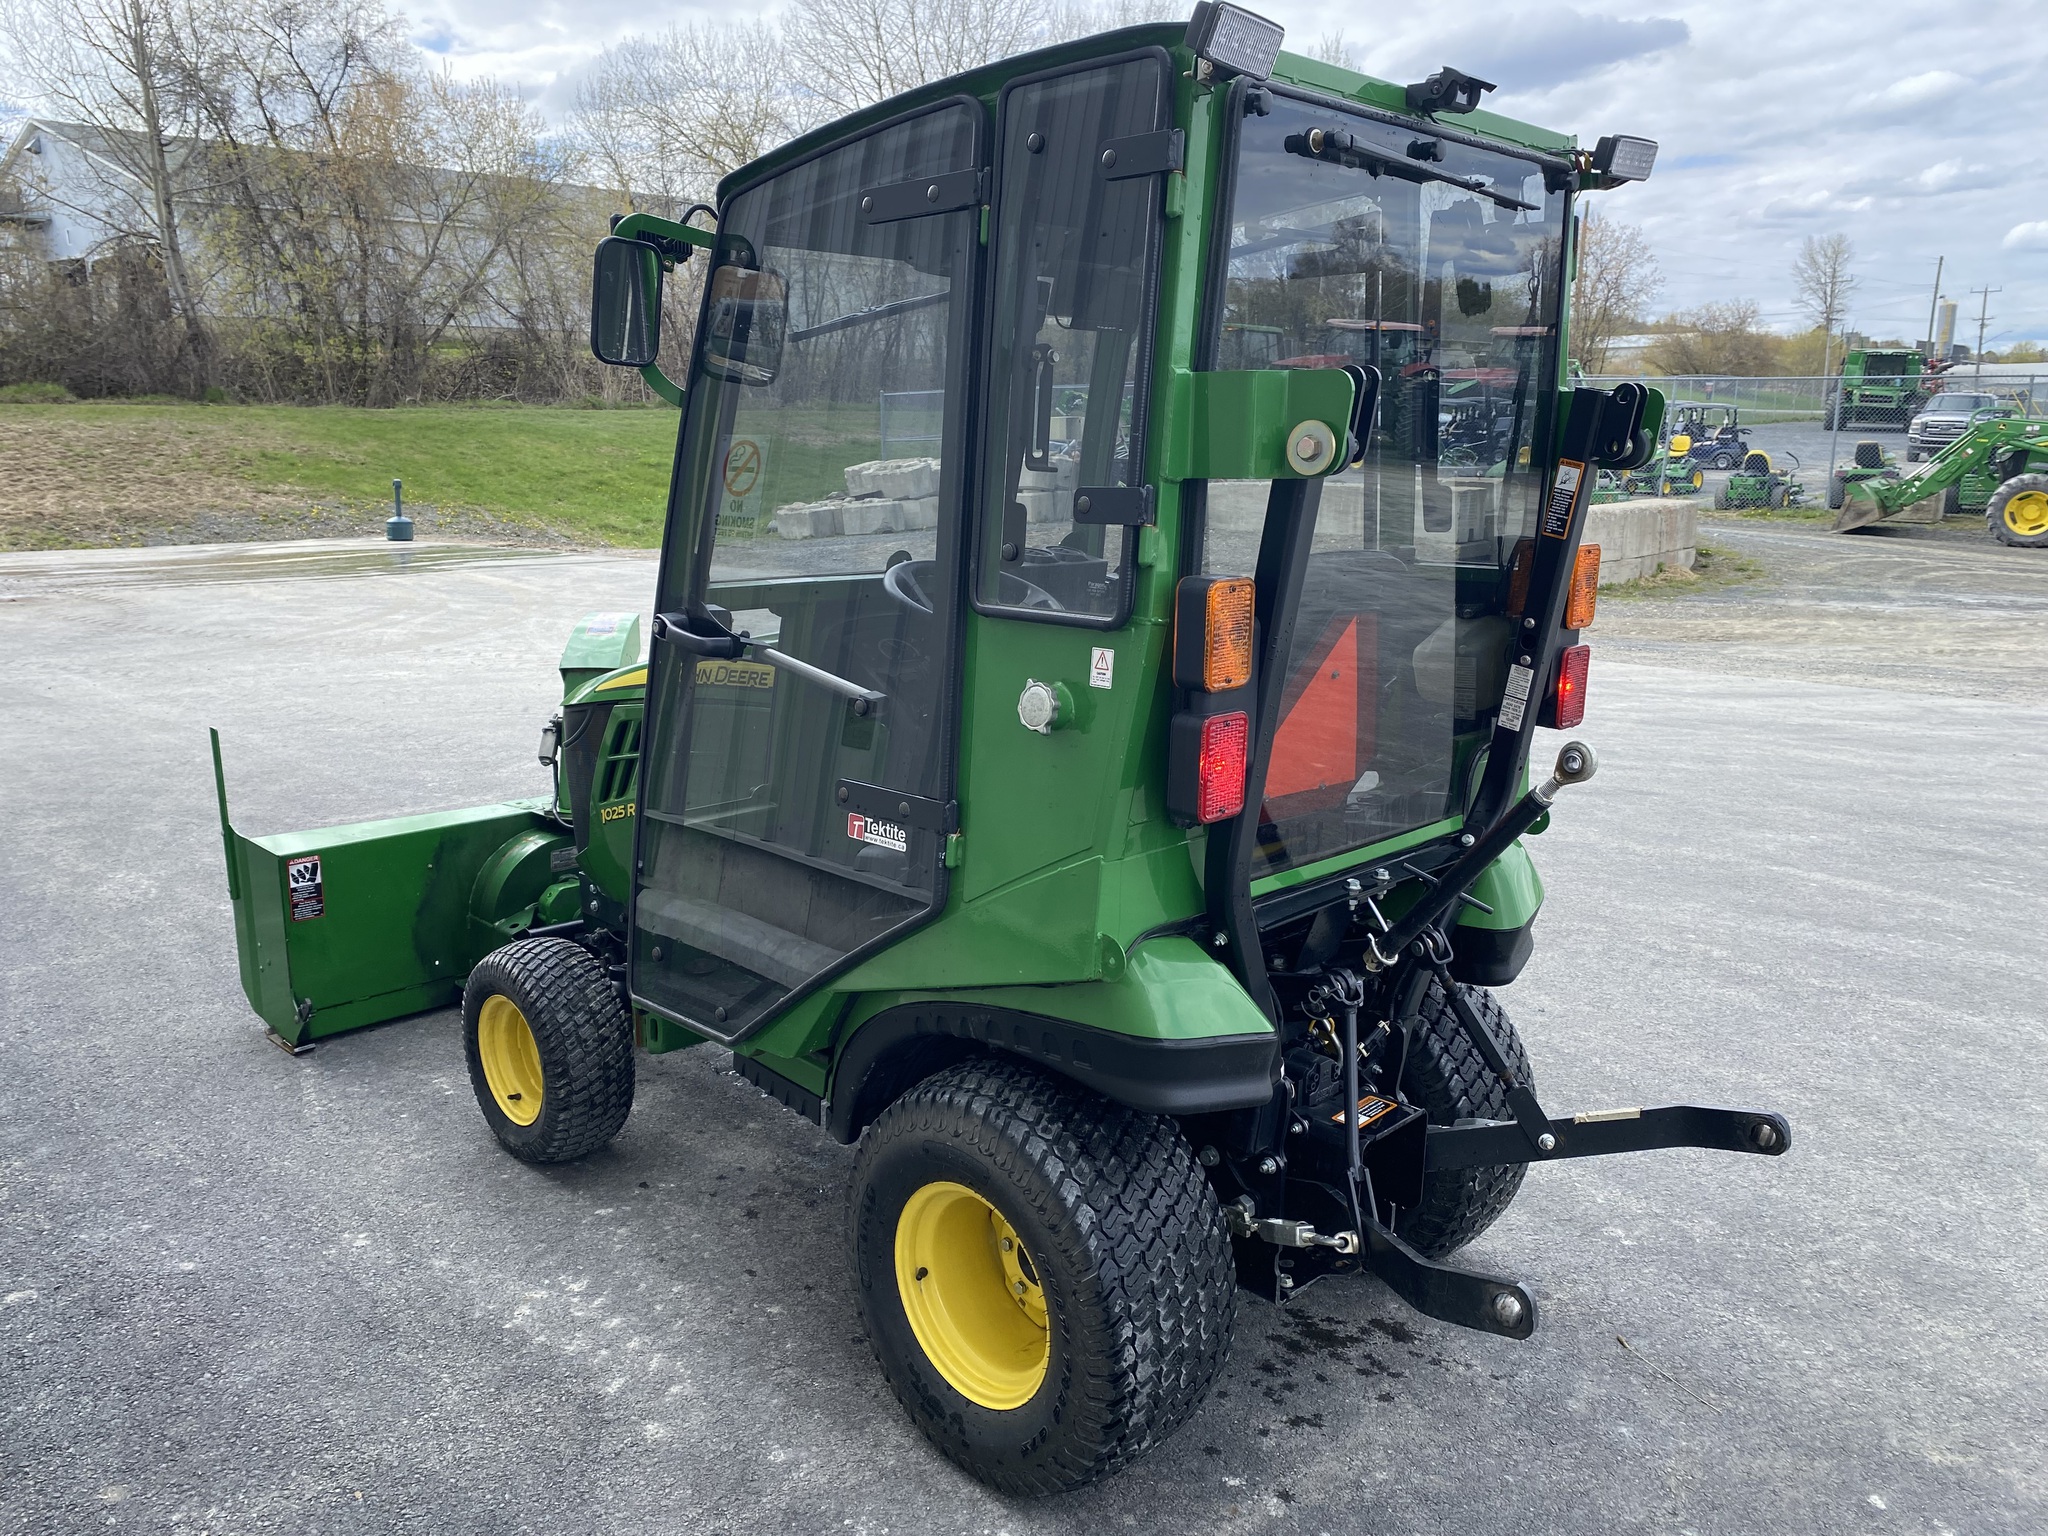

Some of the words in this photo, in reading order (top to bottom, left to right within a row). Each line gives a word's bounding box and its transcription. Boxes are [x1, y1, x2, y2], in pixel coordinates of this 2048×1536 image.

[714, 666, 771, 686] DEERE
[865, 817, 906, 842] Tektite
[294, 855, 319, 864] DANGER
